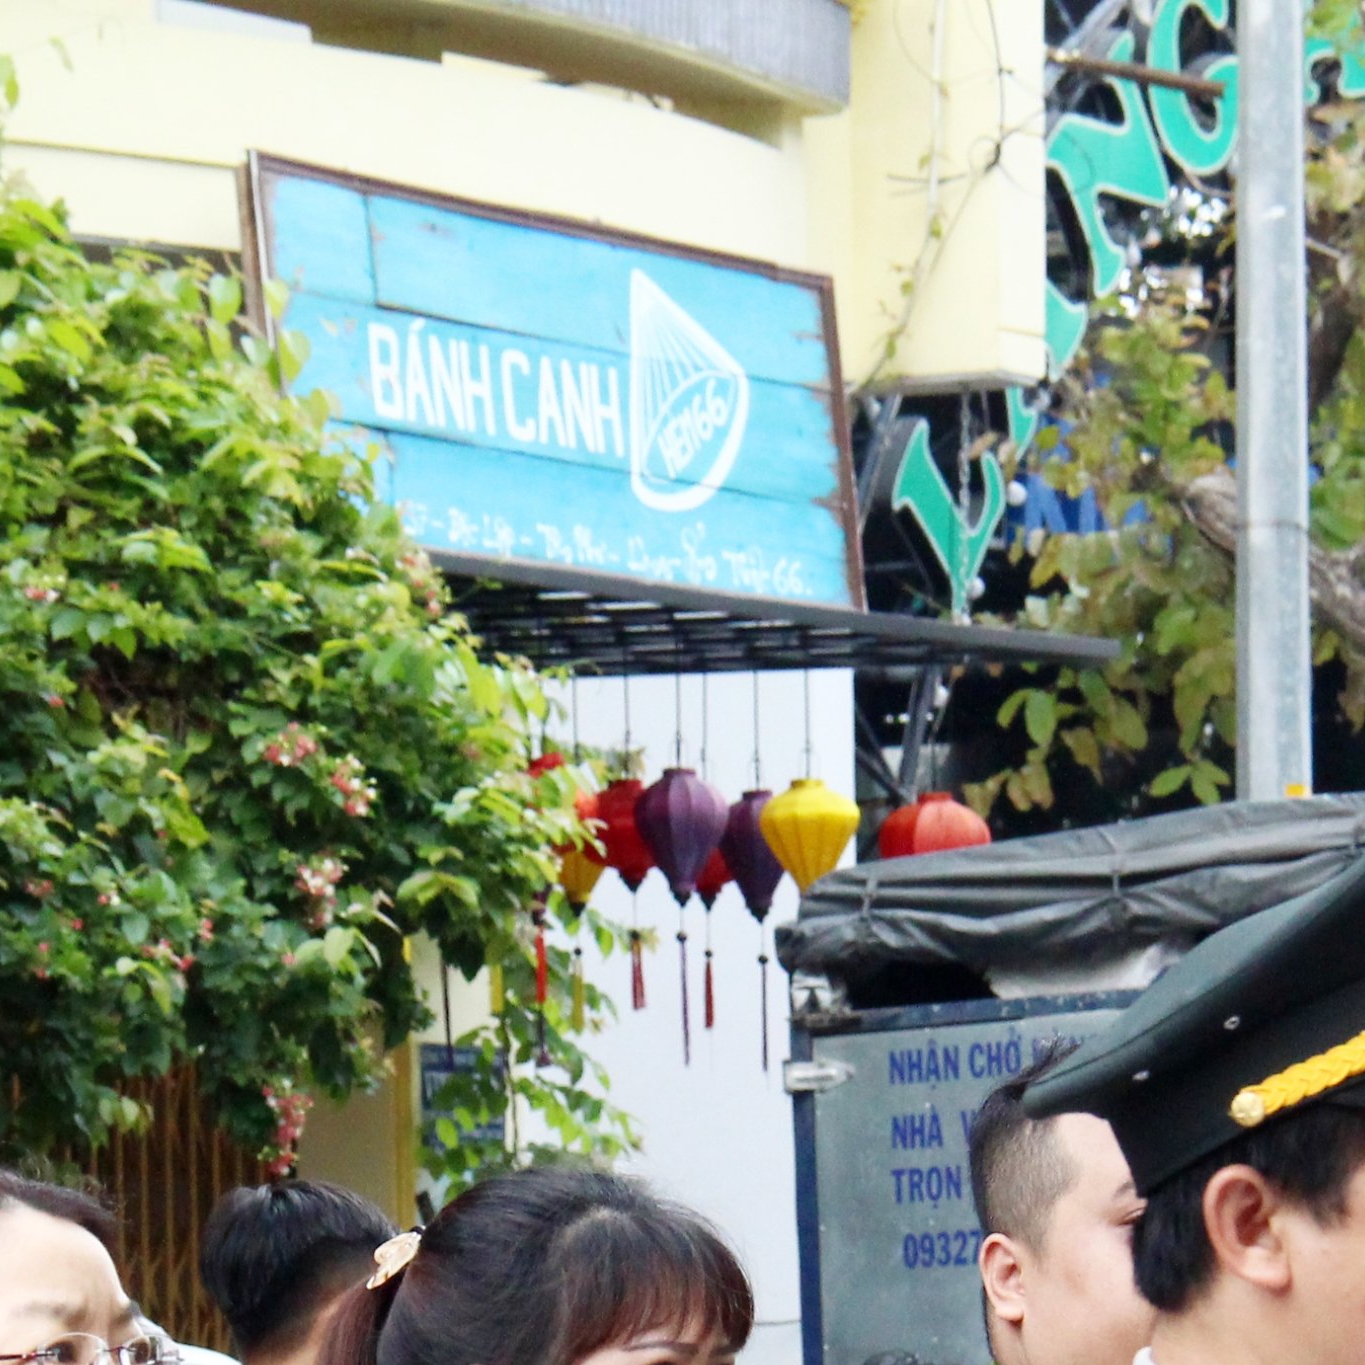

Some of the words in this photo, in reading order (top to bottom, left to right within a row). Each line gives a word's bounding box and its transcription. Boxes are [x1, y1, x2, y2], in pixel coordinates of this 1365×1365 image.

[367, 317, 497, 437] BÁNH
[500, 348, 625, 458] CANH
[888, 1038, 960, 1090] NHẬN
[968, 1026, 1023, 1079] CHỞ
[890, 1164, 962, 1210] TRỌN
[902, 1229, 984, 1270] 09327
